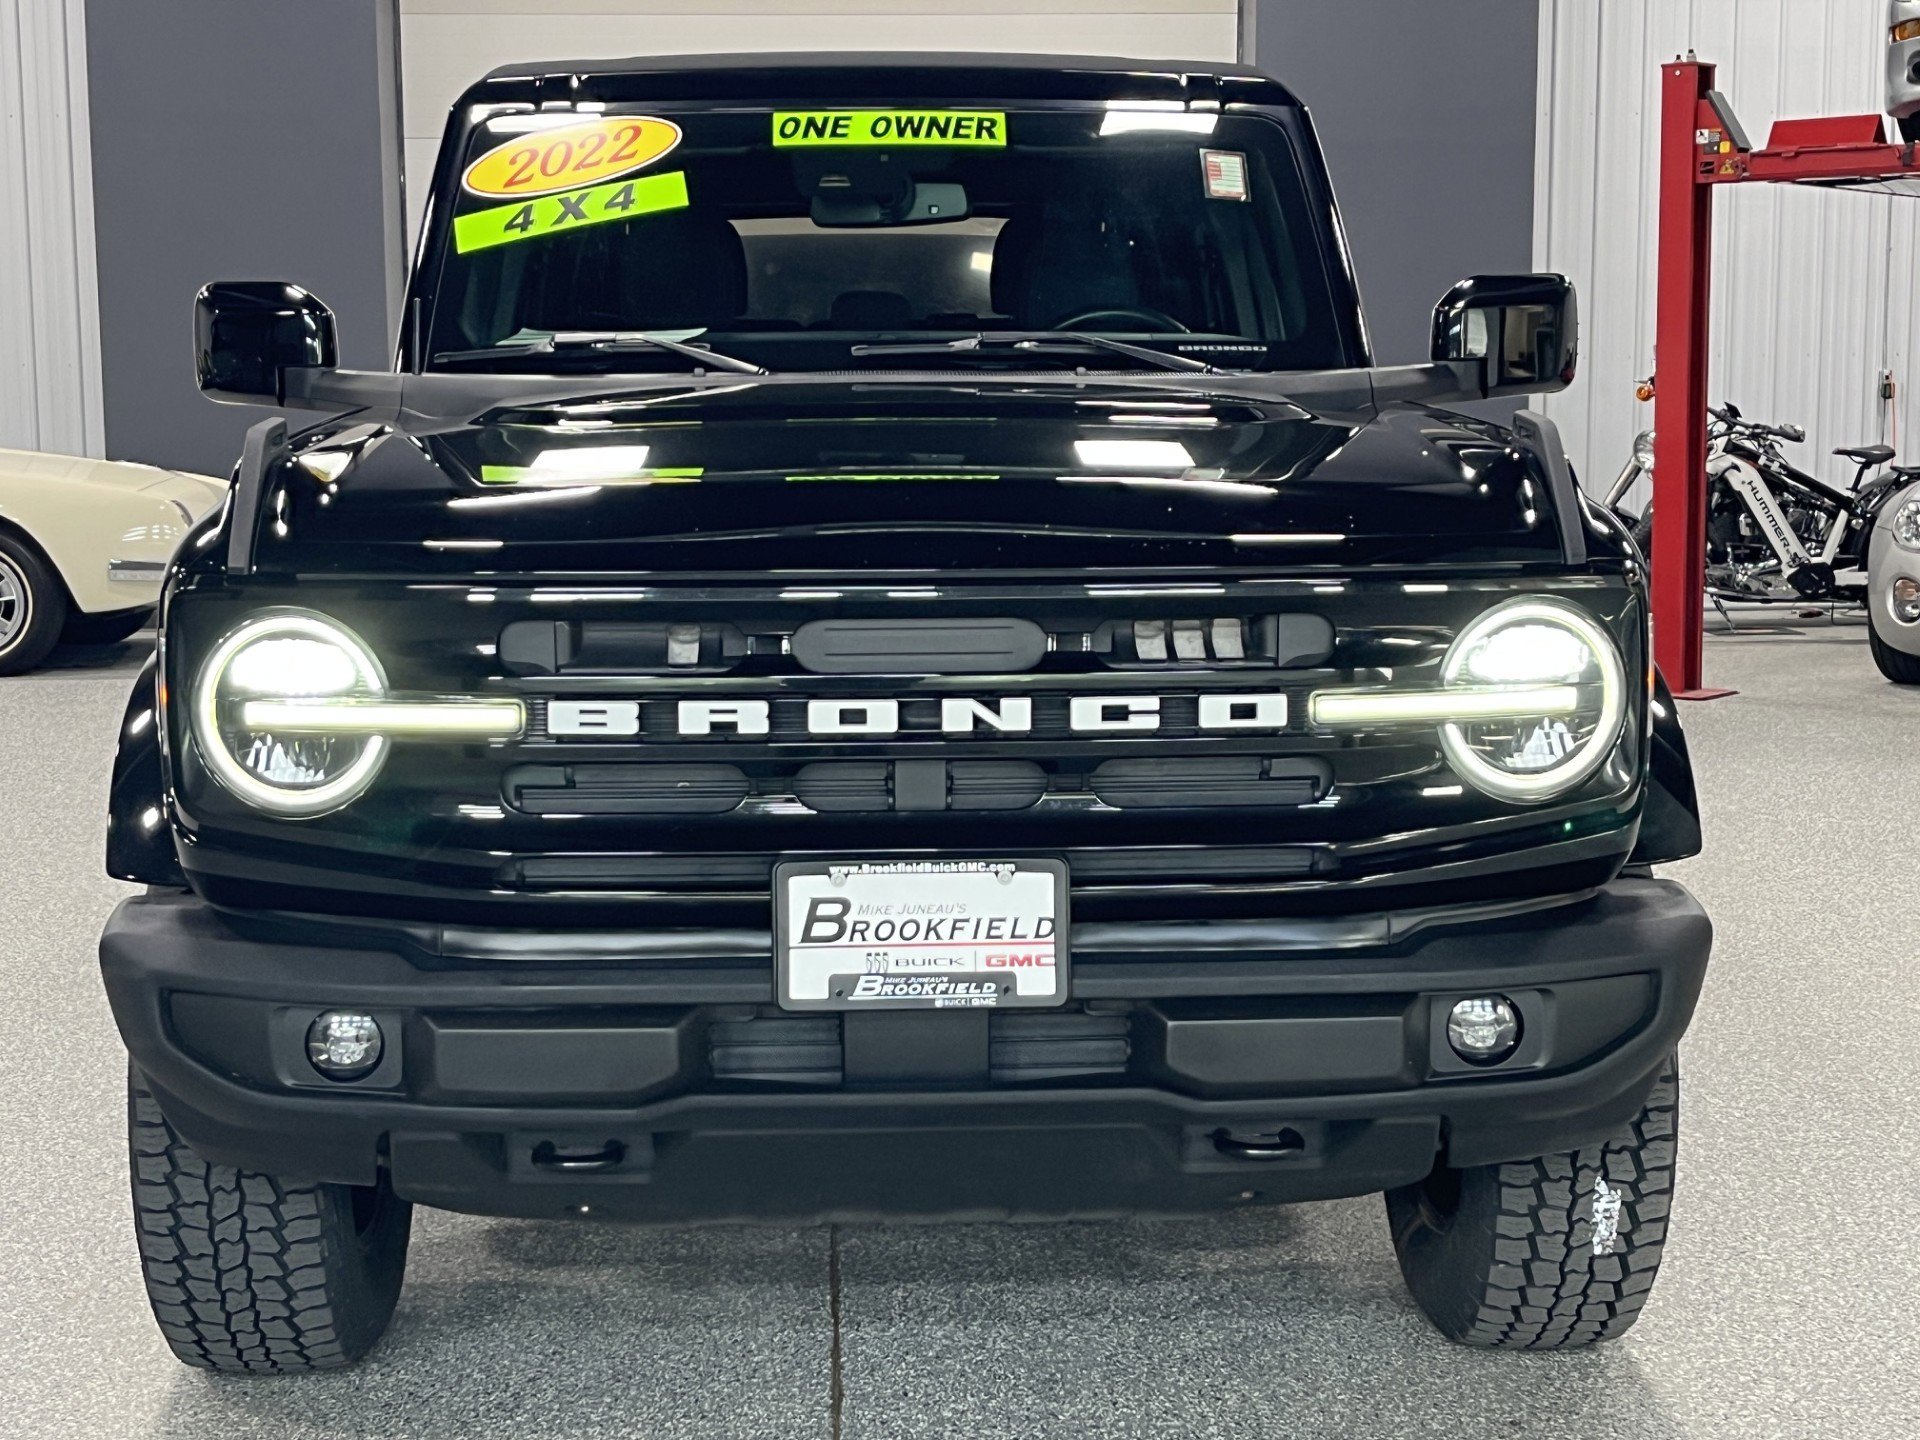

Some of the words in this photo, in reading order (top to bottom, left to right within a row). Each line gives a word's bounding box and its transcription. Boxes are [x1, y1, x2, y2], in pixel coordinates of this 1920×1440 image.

[779, 116, 852, 140] ONE
[870, 116, 999, 141] OWNER
[503, 125, 642, 189] 2022
[1747, 480, 1790, 548] HUMMER
[546, 693, 1289, 737] BRONCO
[829, 862, 1016, 874] www.BrookfieldBuickGMC.com
[798, 896, 1055, 944] BROOKFIELD
[857, 904, 894, 916] MIKE
[897, 903, 967, 916] JUNEAU'S
[895, 957, 966, 967] BUICK
[985, 953, 1056, 968] GMC
[852, 975, 997, 997] BROOKFIELD
